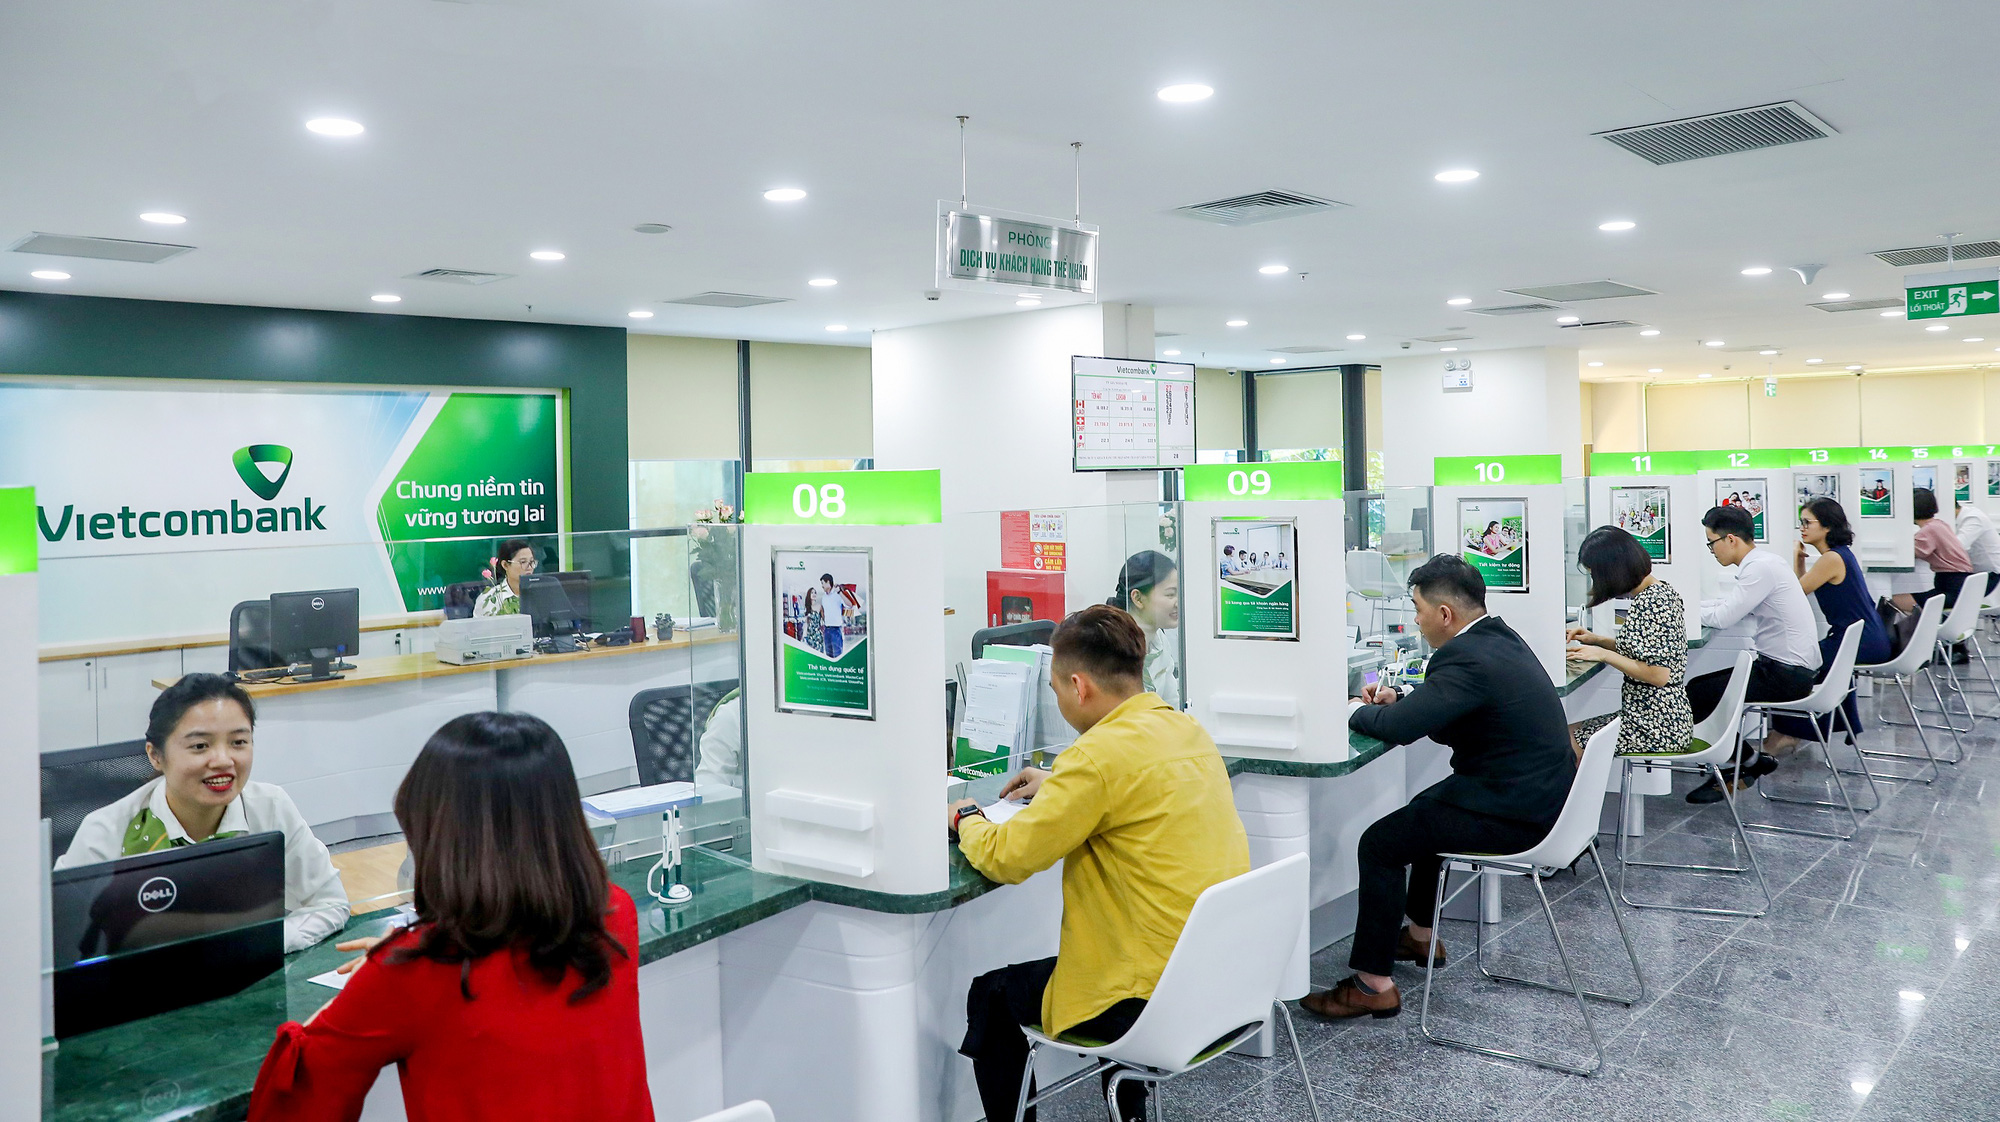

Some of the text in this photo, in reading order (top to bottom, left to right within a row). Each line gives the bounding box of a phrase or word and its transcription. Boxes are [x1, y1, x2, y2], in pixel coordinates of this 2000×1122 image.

[960, 249, 982, 271] DỊCH
[985, 251, 997, 273] VỤ
[999, 251, 1028, 273] KHÁCH
[1030, 254, 1052, 276] HÀNG
[1068, 261, 1088, 281] NHÂN
[1914, 289, 1939, 300] EXIT
[1910, 303, 1921, 312] LỐI
[1116, 365, 1150, 375] Vietcombank
[1727, 453, 1750, 467] 12
[1809, 450, 1829, 462] 13
[1868, 448, 1888, 460] 14
[1911, 448, 1929, 458] 15
[1631, 455, 1651, 472] 11
[1474, 462, 1505, 482] 10
[396, 476, 545, 501] Chung niềm tin
[1227, 470, 1272, 496] 09
[792, 483, 846, 518] 08
[37, 497, 327, 542] Vietcombank
[405, 505, 545, 528] vững tương lai
[828, 665, 842, 673] dụng
[143, 888, 173, 900] DELL
